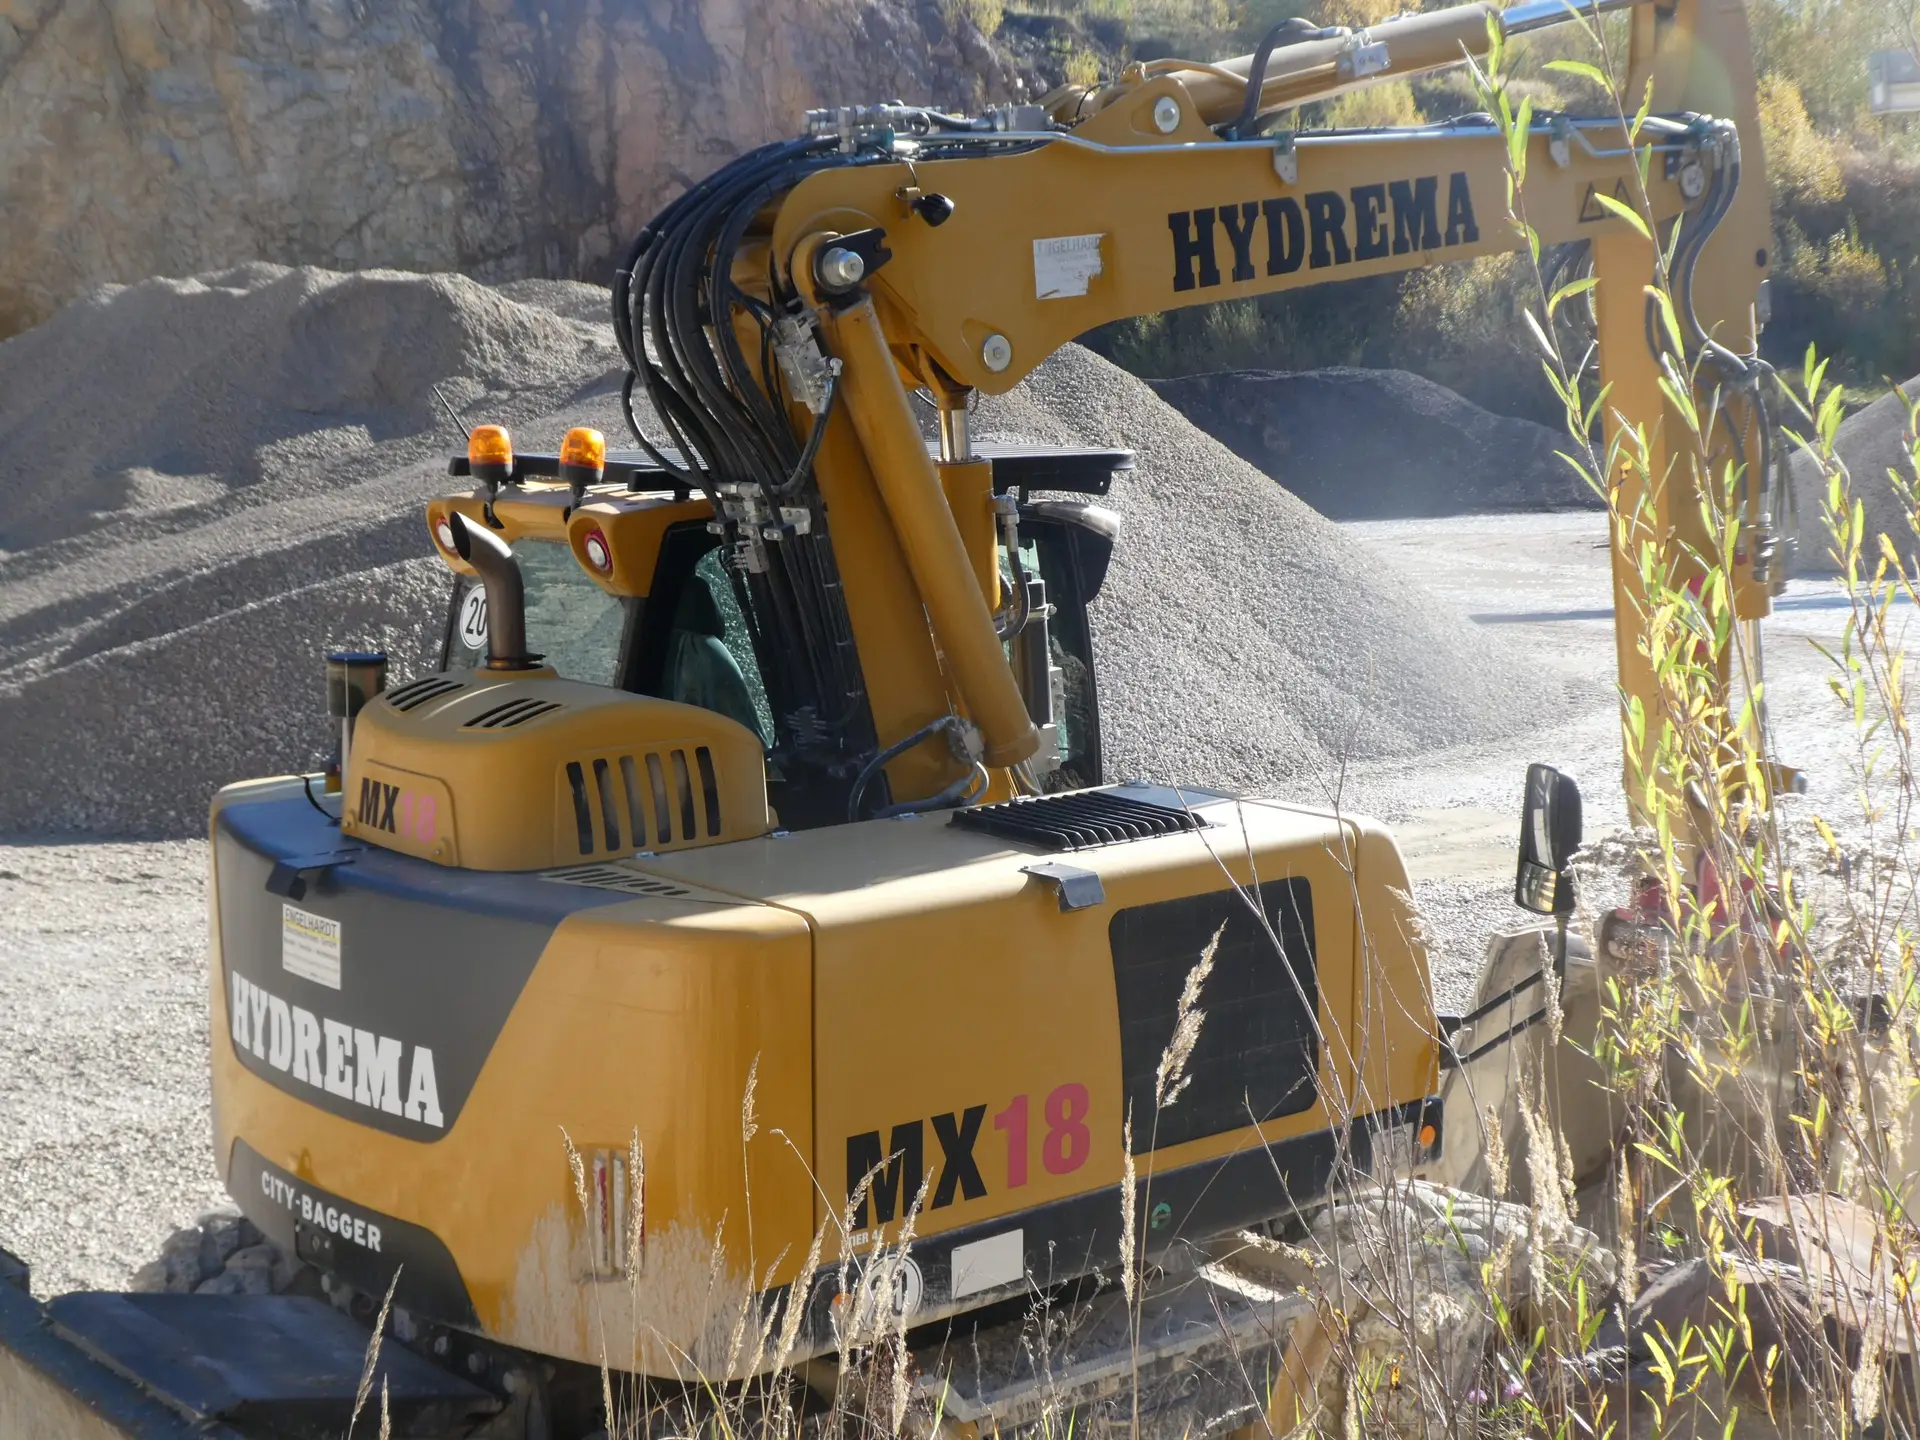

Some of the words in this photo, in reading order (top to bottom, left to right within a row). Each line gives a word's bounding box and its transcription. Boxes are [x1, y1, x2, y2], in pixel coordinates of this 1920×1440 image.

[1168, 172, 1479, 292] HYDREMA
[465, 596, 487, 636] 20
[358, 777, 436, 843] MX18
[232, 970, 444, 1128] HYDREMA
[846, 1082, 1090, 1232] MX18
[259, 1167, 382, 1252] CITY-BAGGER
